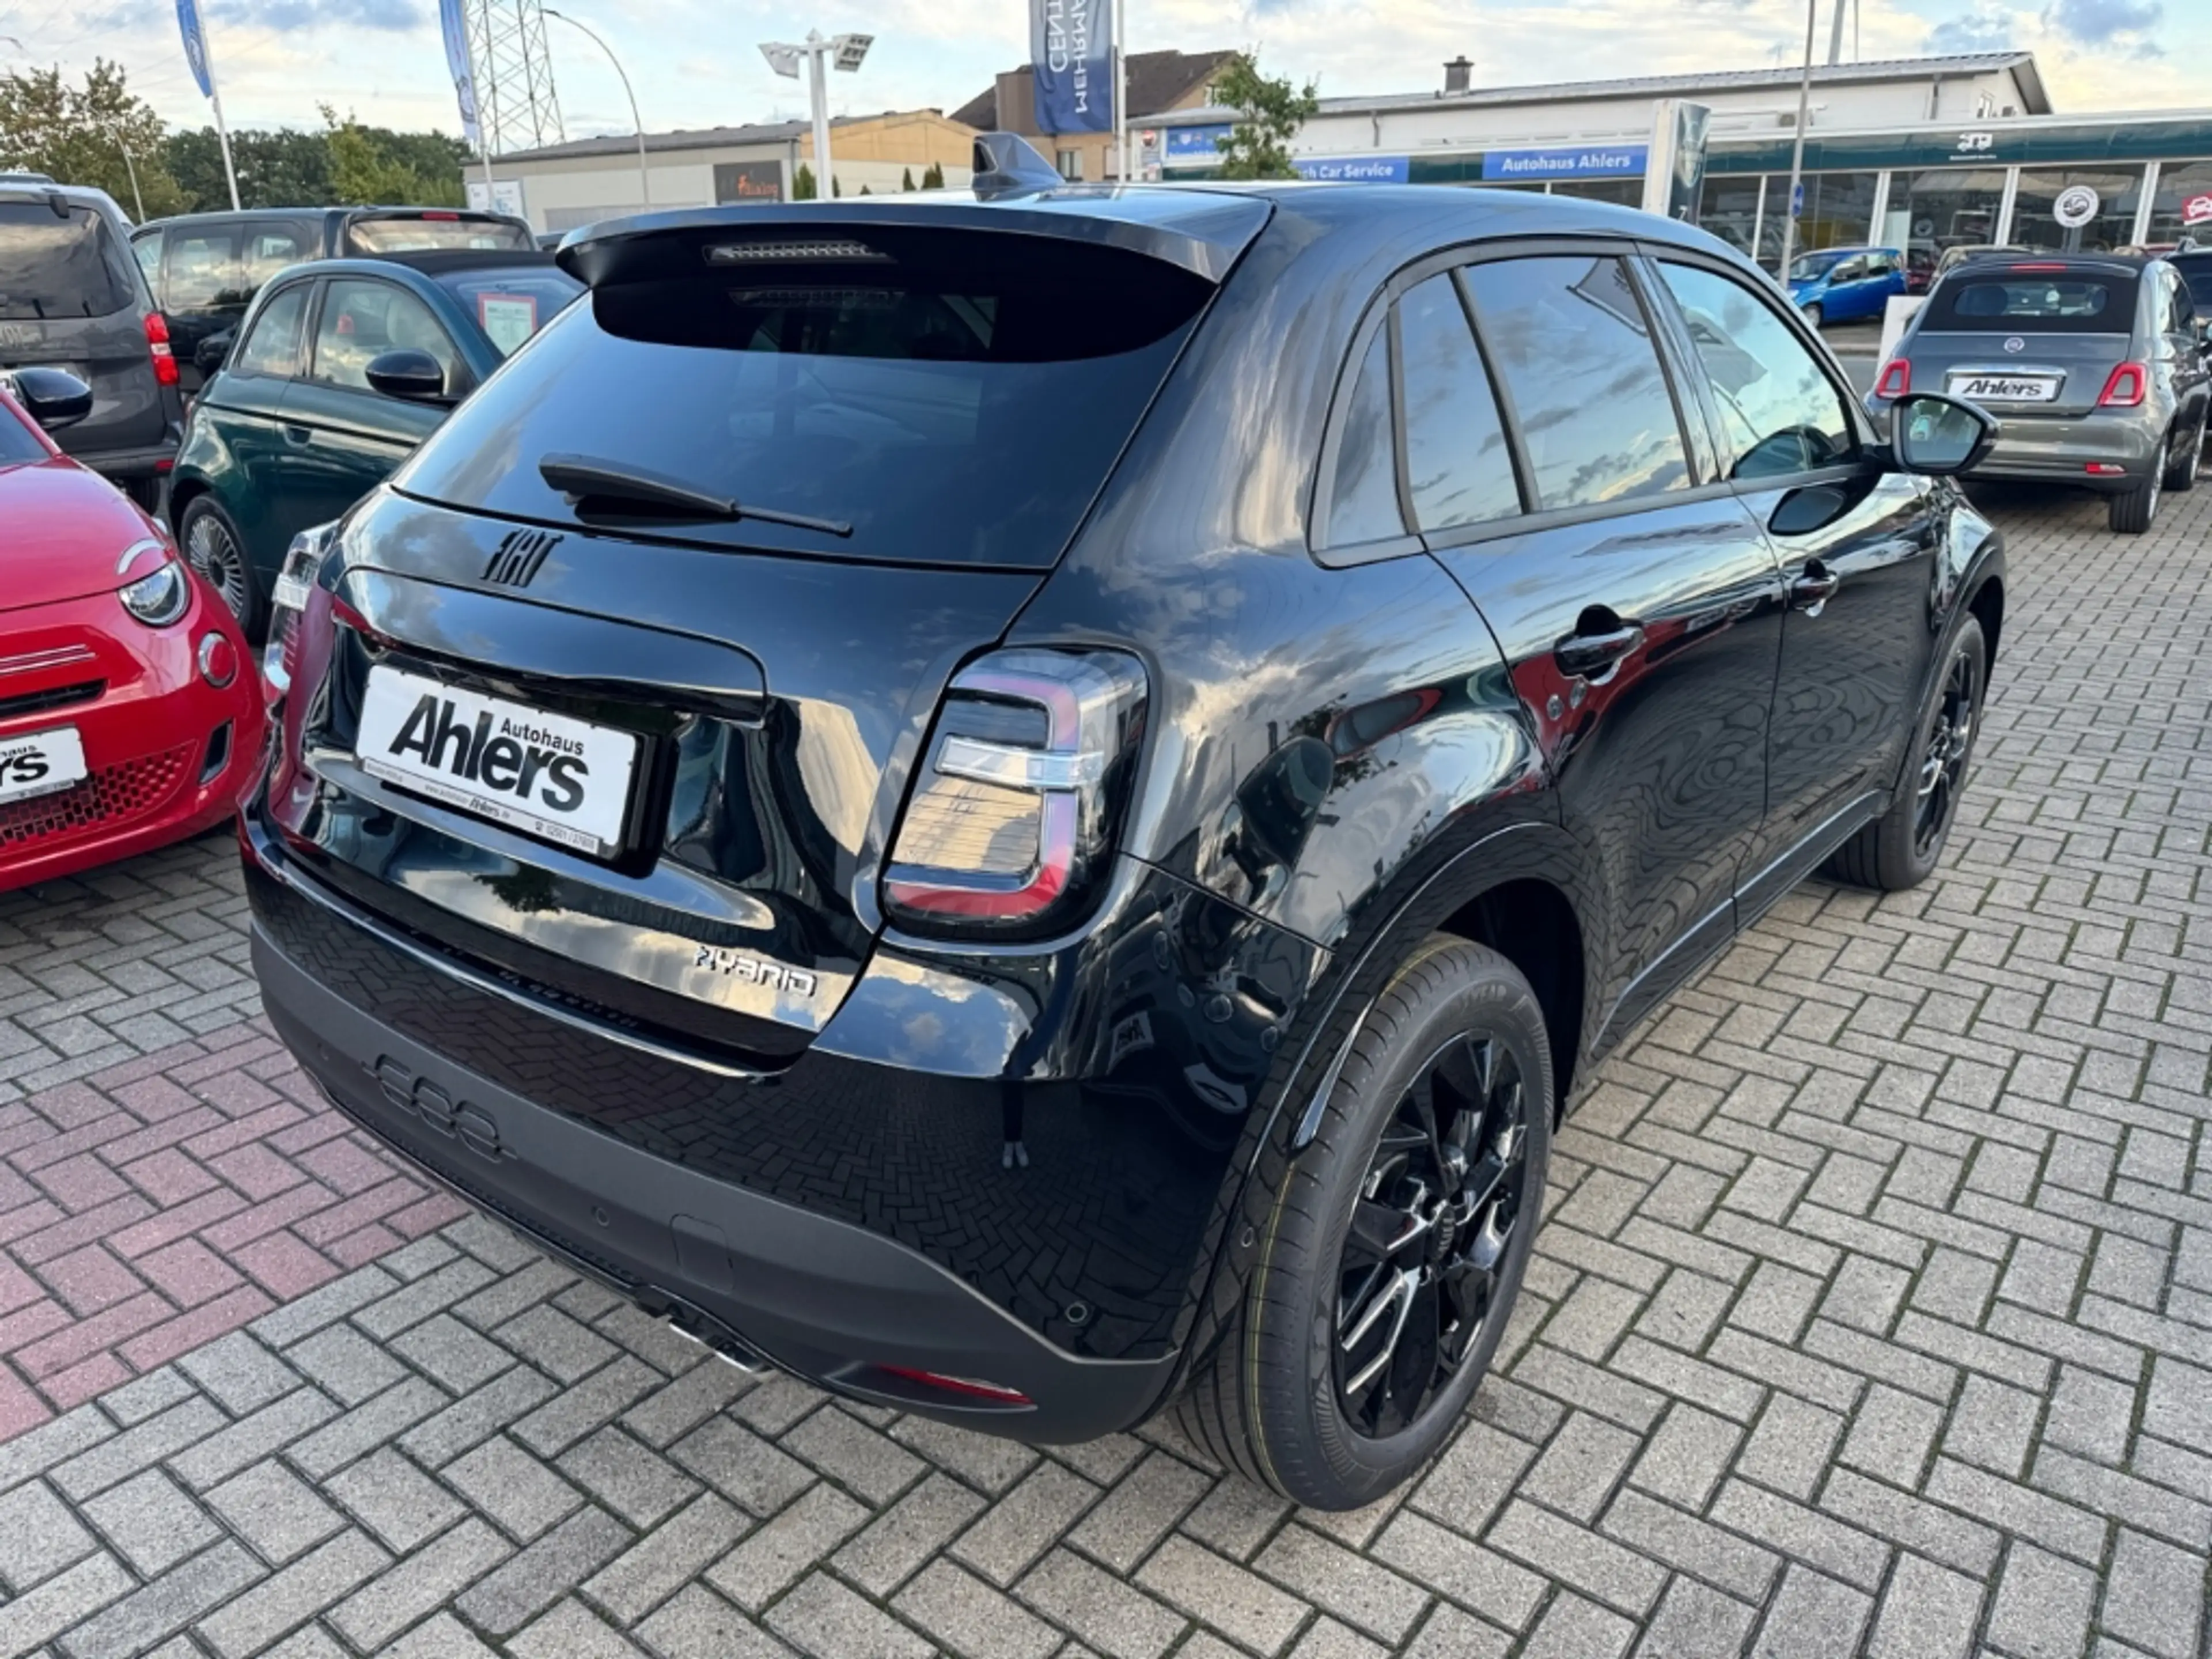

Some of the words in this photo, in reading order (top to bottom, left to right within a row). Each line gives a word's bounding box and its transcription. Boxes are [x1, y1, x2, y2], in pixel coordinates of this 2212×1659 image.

[1319, 165, 1342, 179] Car
[1343, 161, 1395, 178] Service
[1501, 156, 1574, 172] Autohaus
[1578, 152, 1631, 168] Ahlers
[1961, 379, 2043, 396] Ahlers
[499, 717, 584, 756] Autohaus
[388, 694, 589, 812] Ahlers
